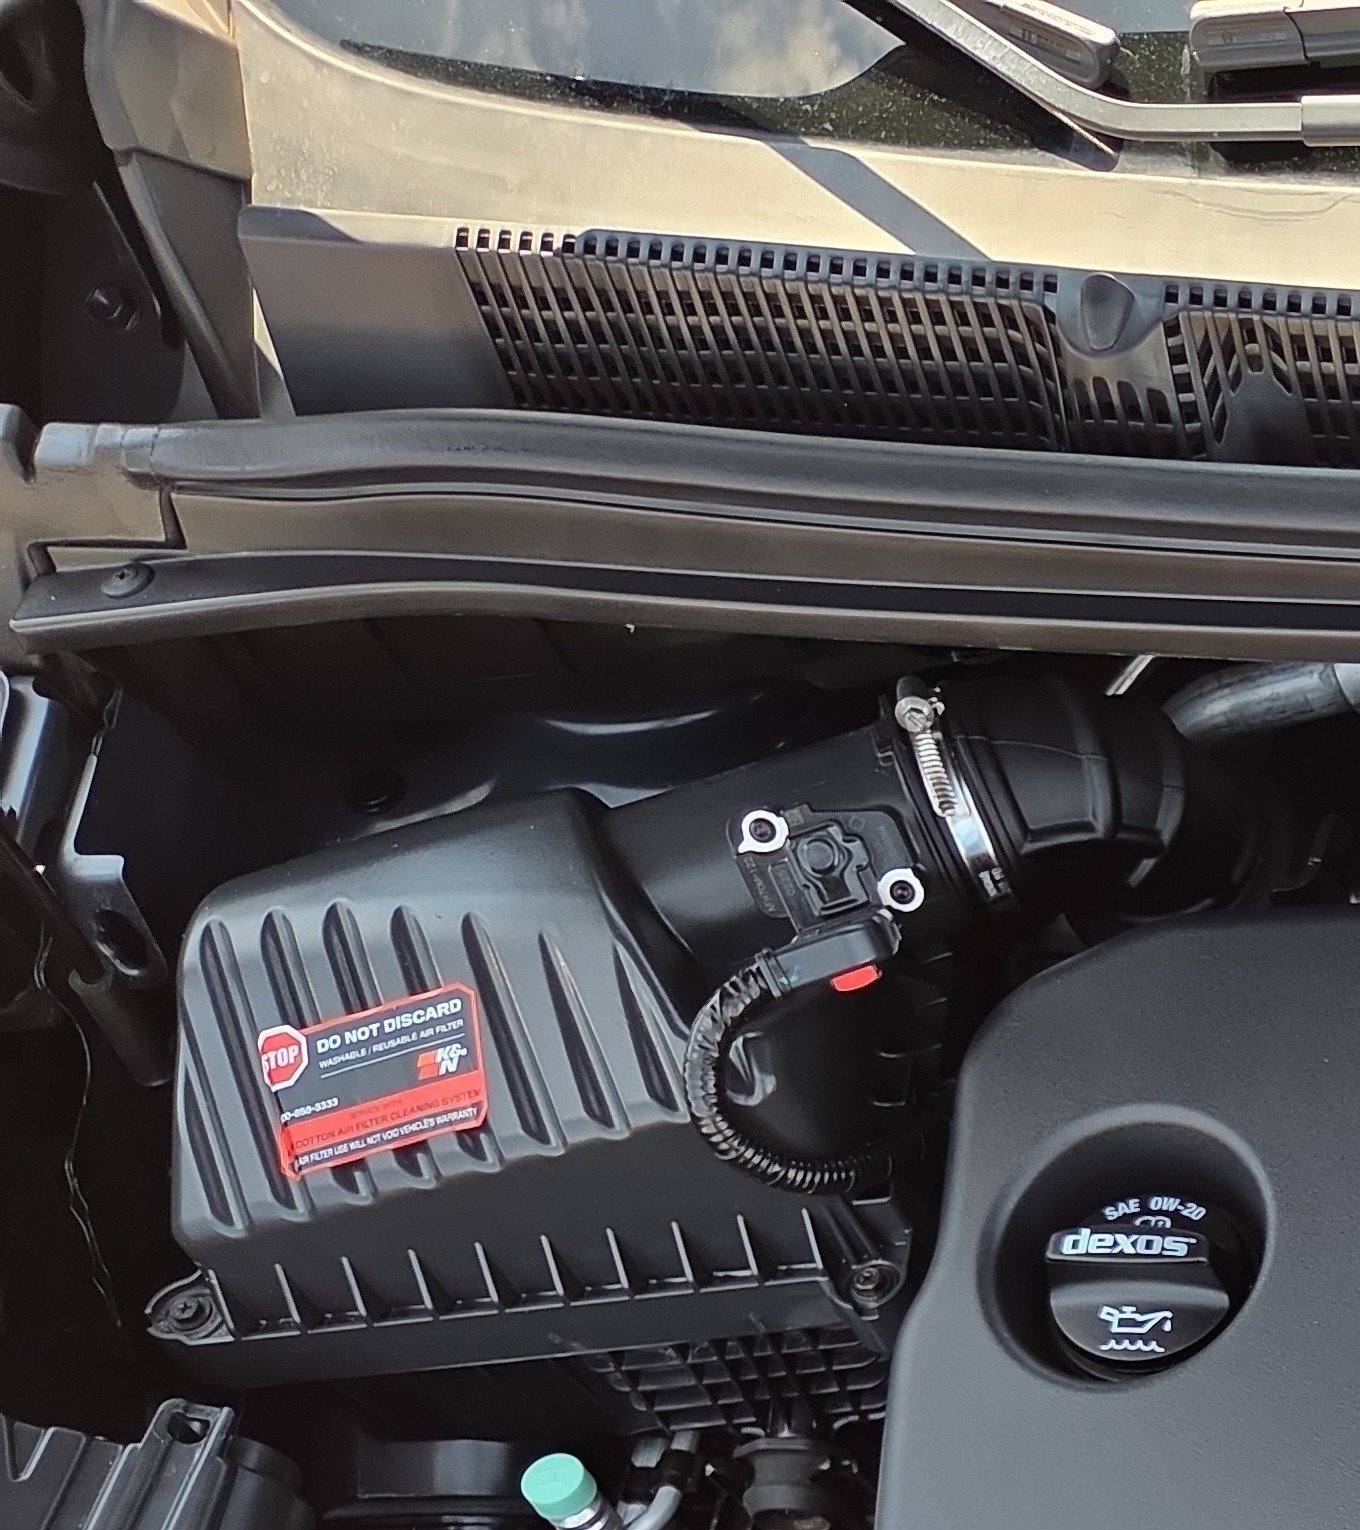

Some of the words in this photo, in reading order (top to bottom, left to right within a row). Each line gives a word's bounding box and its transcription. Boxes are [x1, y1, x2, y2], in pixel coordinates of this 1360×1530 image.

[316, 1035, 341, 1053] DO
[344, 1023, 380, 1044] NOT
[383, 999, 461, 1033] DISCARD
[319, 1048, 366, 1068] WASHABLE
[372, 1032, 418, 1052] REUSABLE
[420, 1028, 434, 1038] AIR
[435, 1019, 463, 1034] FILTER
[261, 1045, 299, 1075] STOP
[295, 1129, 337, 1149] COTTON
[336, 1123, 354, 1137] AIR
[354, 1113, 388, 1131] FILTER
[389, 1098, 441, 1121] CLEANING
[440, 1085, 482, 1106] SYSTEM
[349, 1139, 366, 1150] WILL
[1103, 1198, 1141, 1221] SAE
[1149, 1196, 1207, 1220] 0W-20
[1062, 1227, 1197, 1257] dexos
